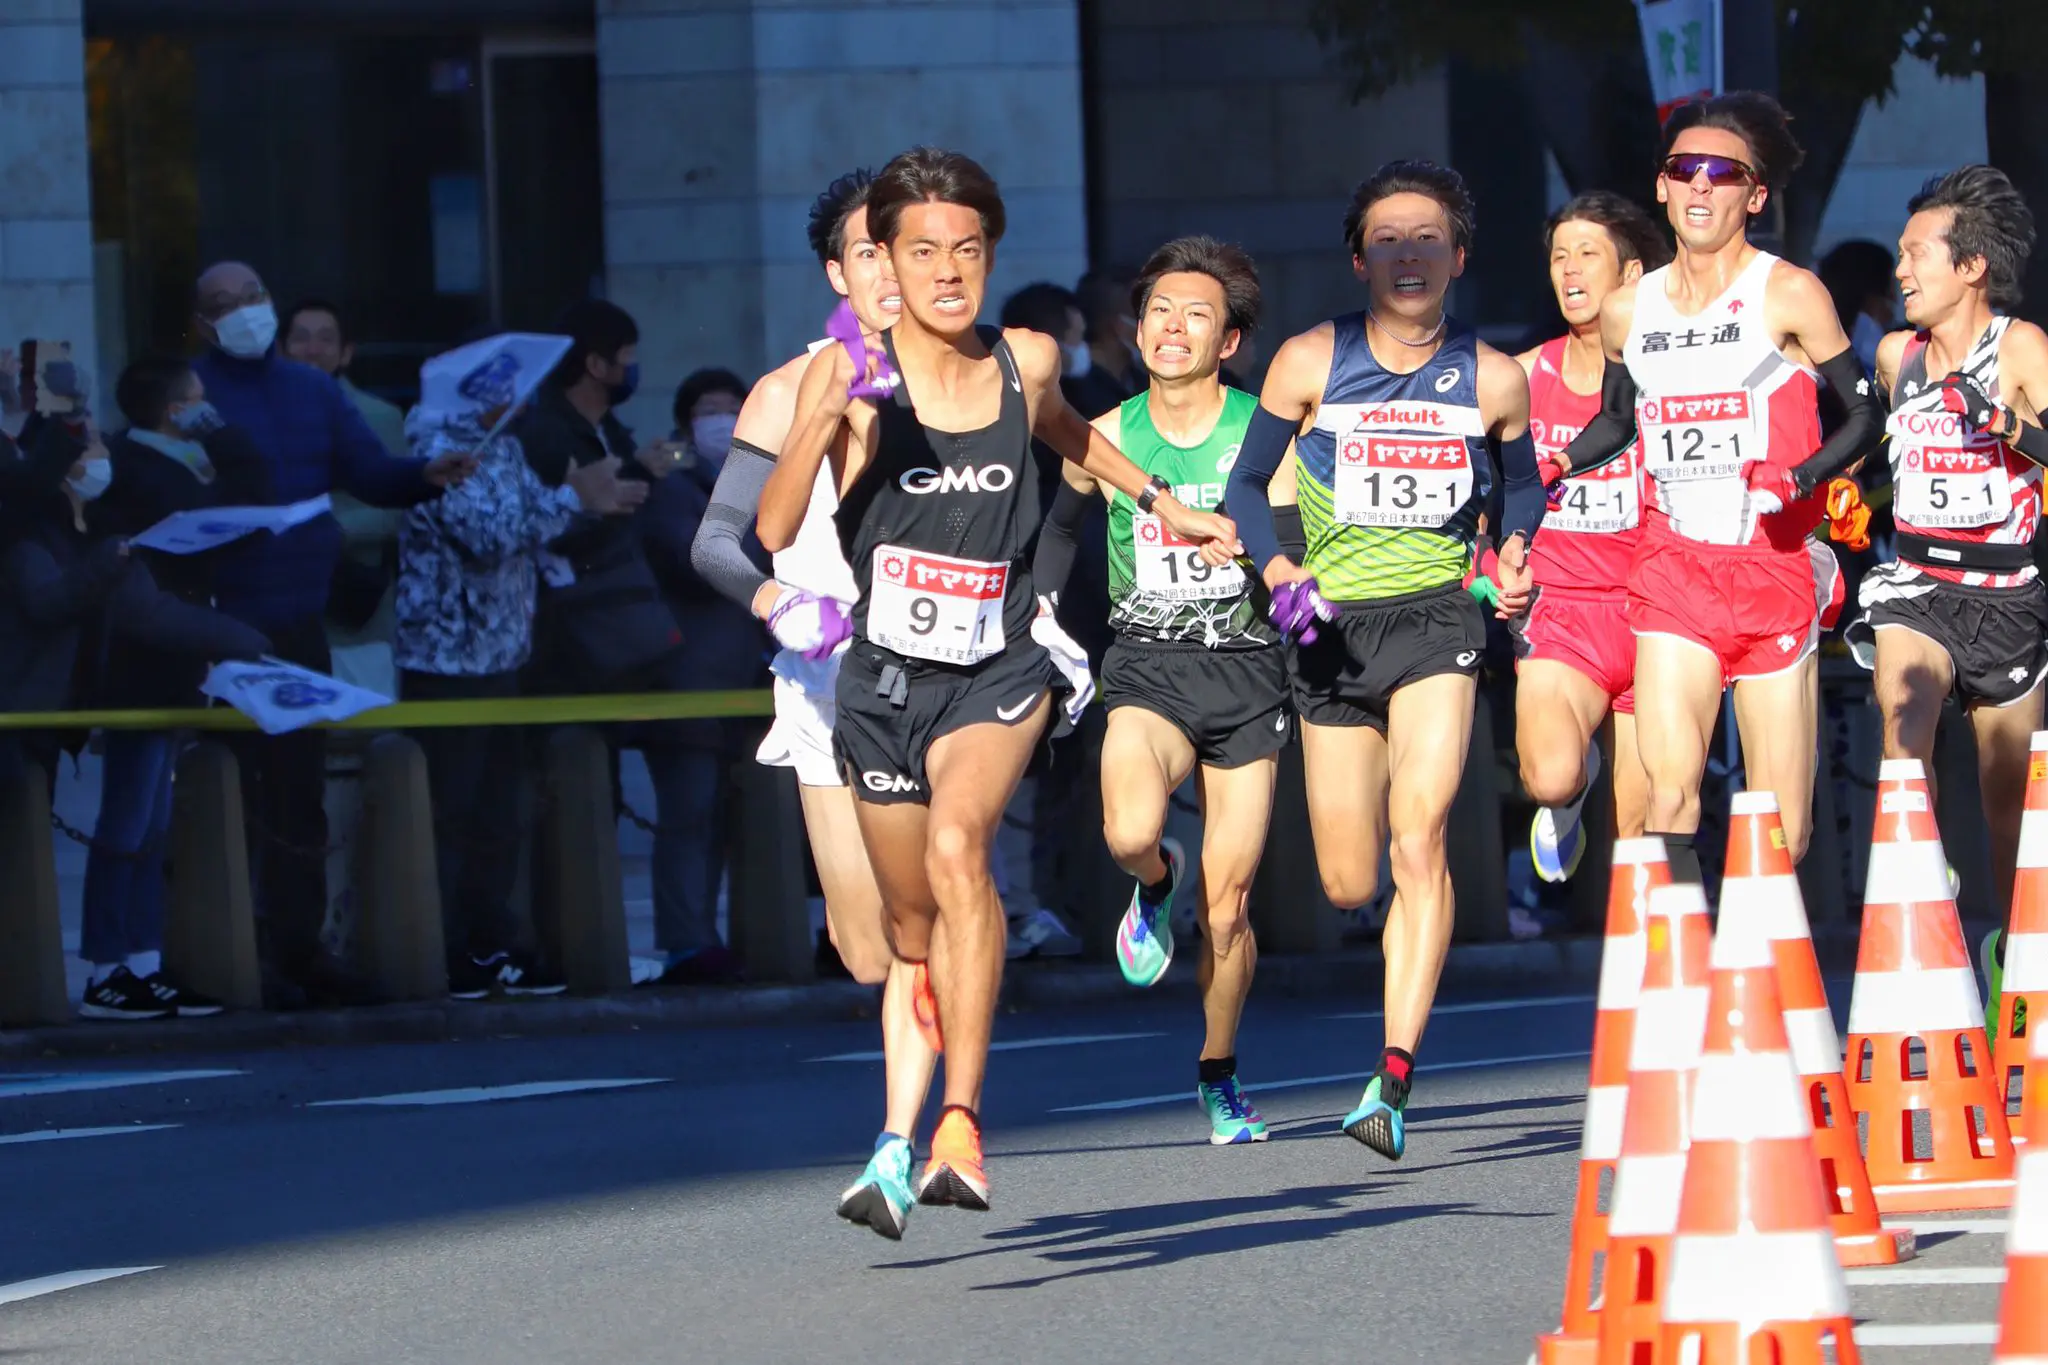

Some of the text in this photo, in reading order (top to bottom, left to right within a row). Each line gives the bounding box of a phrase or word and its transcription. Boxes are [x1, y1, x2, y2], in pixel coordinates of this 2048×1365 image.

[1642, 322, 1741, 353] 富士通
[1359, 407, 1445, 426] Yakult
[1665, 396, 1743, 419] ヤマザキ
[1374, 443, 1462, 464] ヤマザキ
[1661, 427, 1741, 462] 12-1
[899, 464, 1014, 494] GMO
[1364, 472, 1456, 509] 13-1
[1172, 483, 1225, 508] 東日
